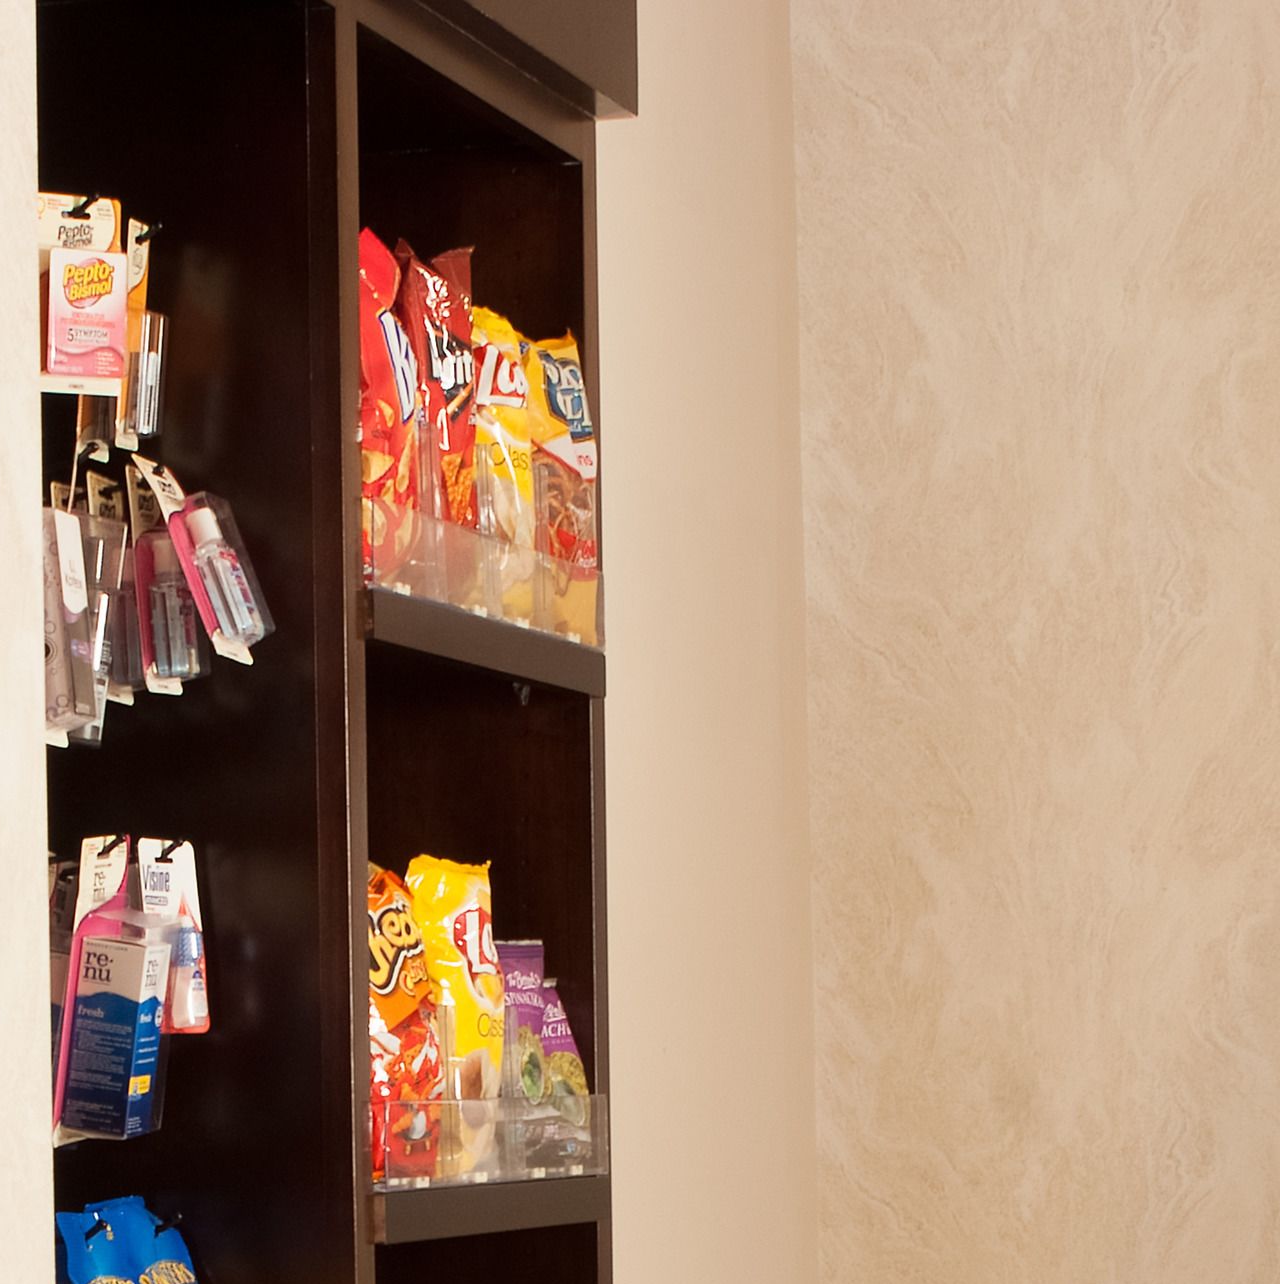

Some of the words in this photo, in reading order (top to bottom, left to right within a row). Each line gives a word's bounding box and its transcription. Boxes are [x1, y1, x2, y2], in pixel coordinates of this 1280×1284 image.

[63, 263, 115, 285] Pepto-
[70, 278, 113, 300] Bismol
[83, 965, 112, 982] nu
